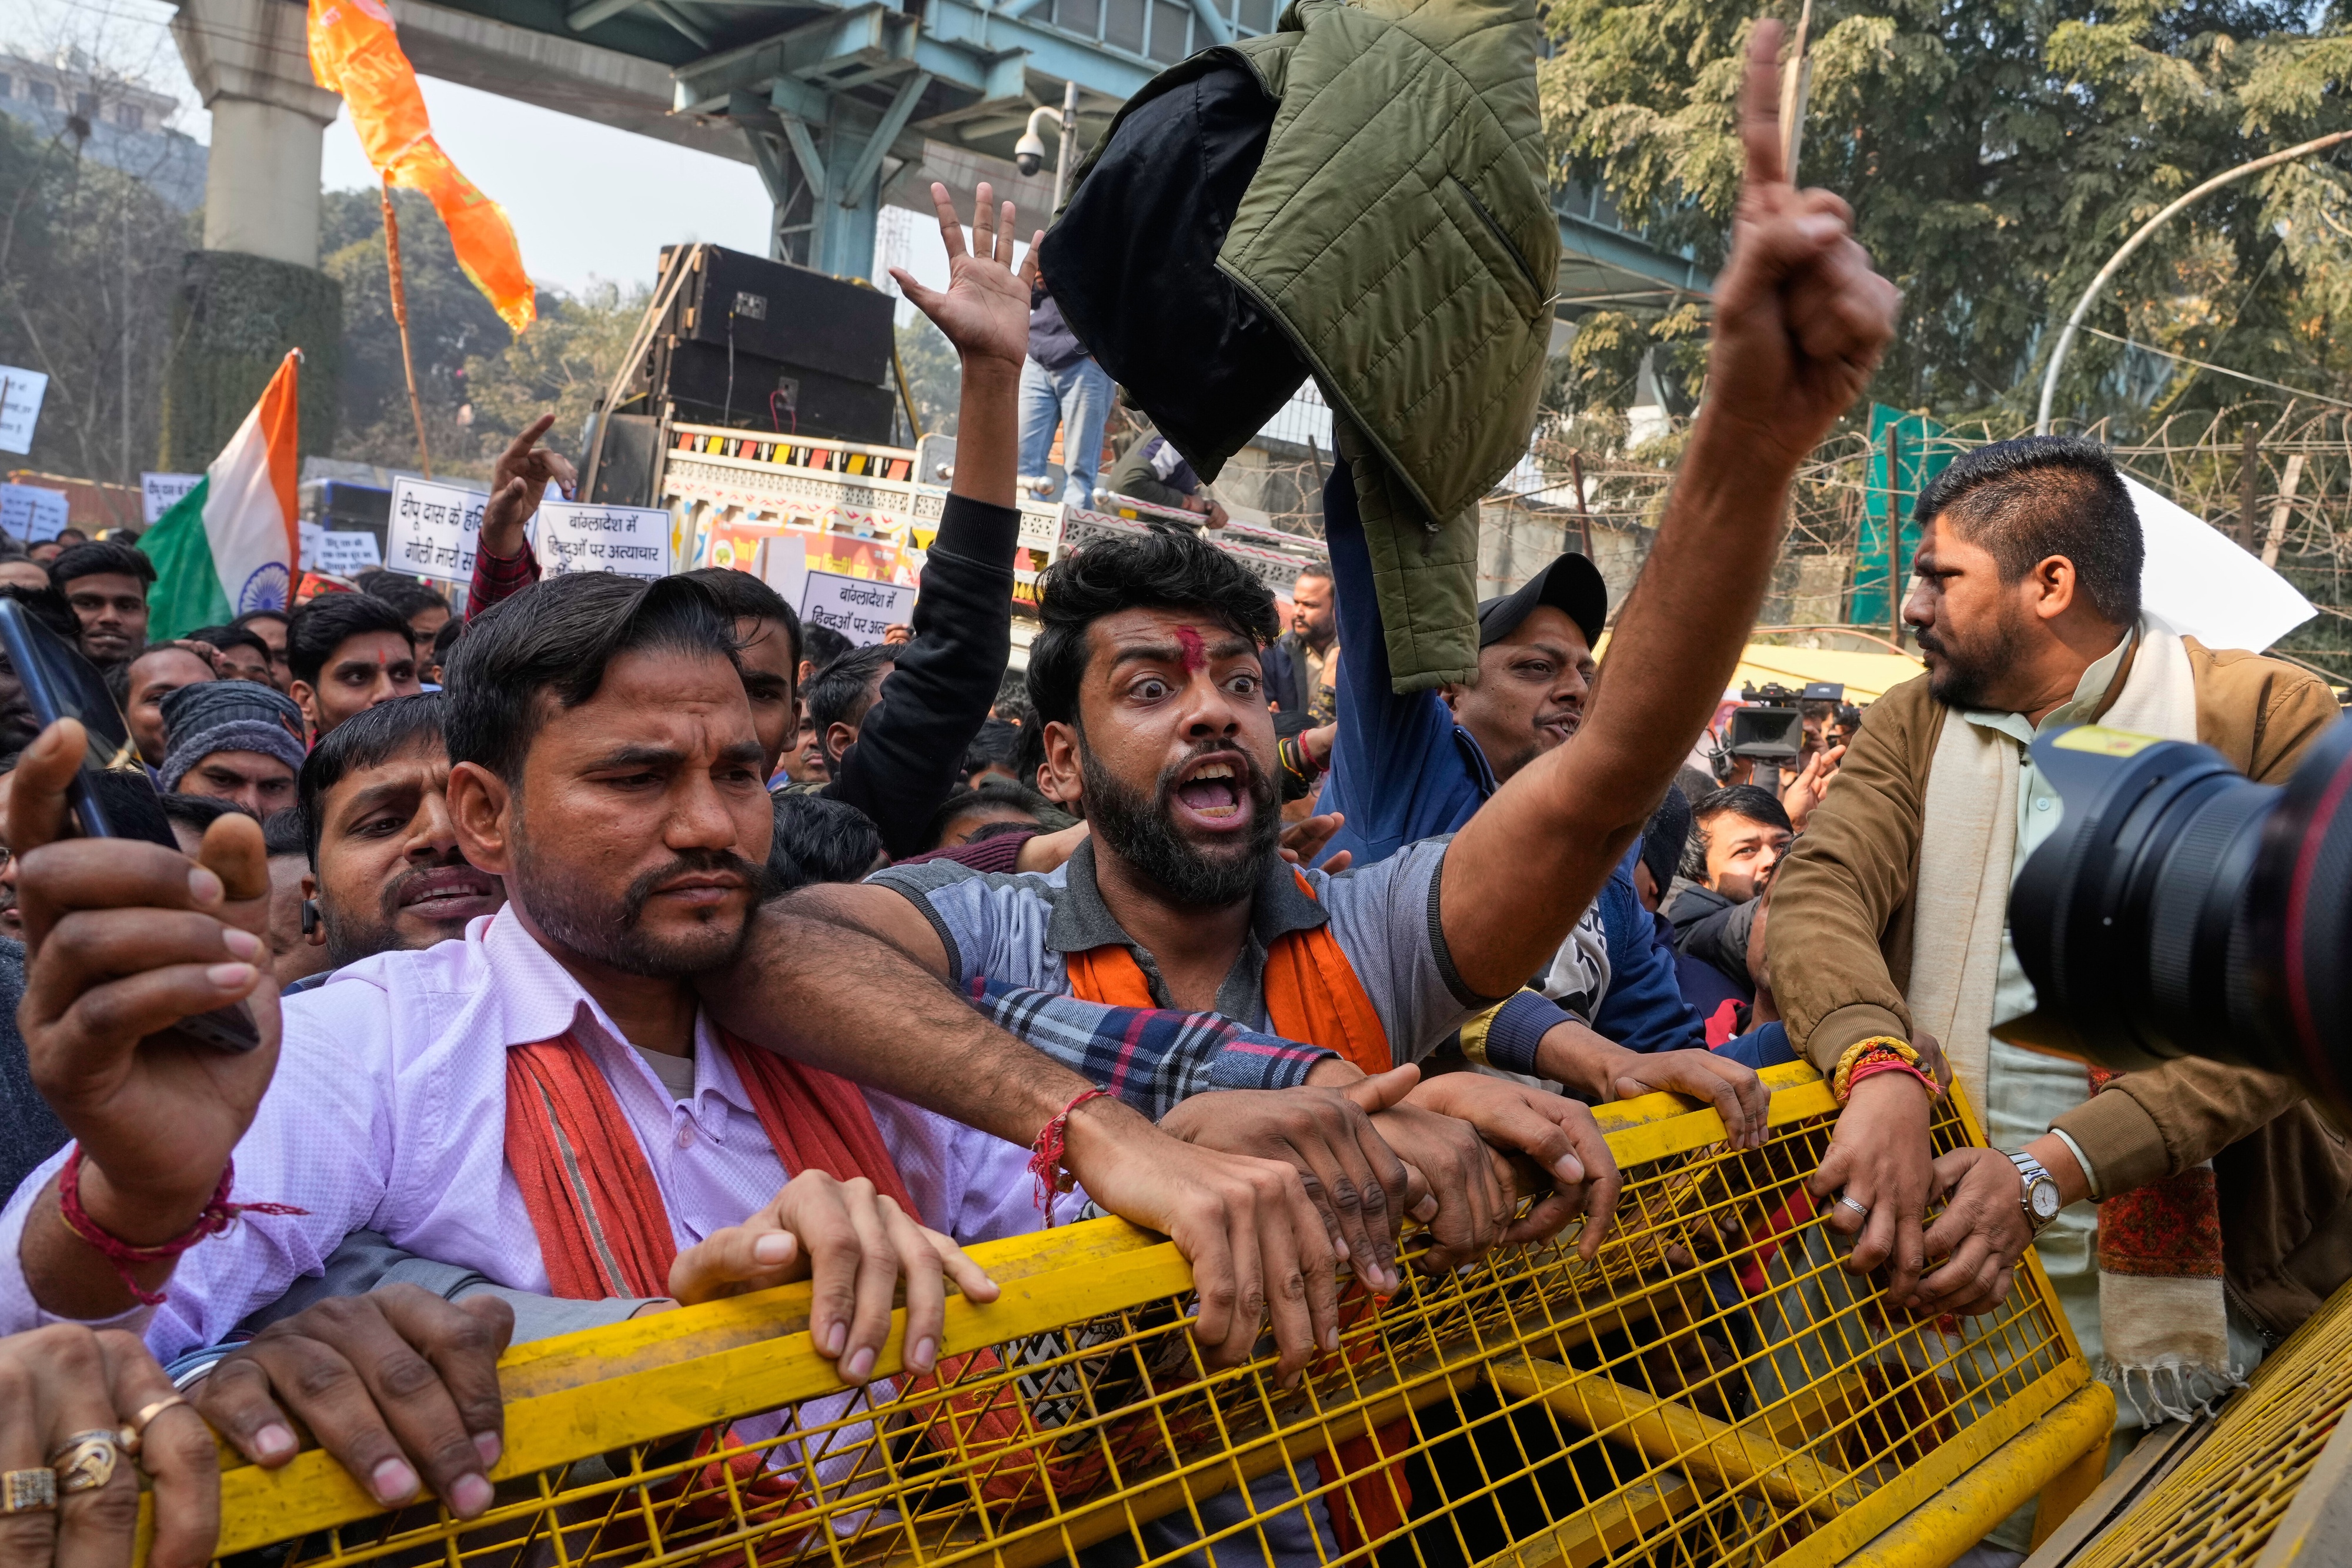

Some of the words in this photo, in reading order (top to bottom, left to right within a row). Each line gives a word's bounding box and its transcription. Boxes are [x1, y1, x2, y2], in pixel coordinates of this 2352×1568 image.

[400, 492, 421, 530] दीपू
[423, 503, 446, 524] दास
[448, 502, 463, 526] के
[569, 511, 622, 533] बांग्लादेश
[626, 513, 639, 533] में
[405, 536, 433, 564] गोली
[436, 542, 460, 568] मारो
[547, 535, 587, 563] हिन्दुओं
[589, 543, 606, 557] पर
[607, 544, 659, 561] अत्याचार
[886, 591, 897, 609] में
[854, 617, 868, 633] पर
